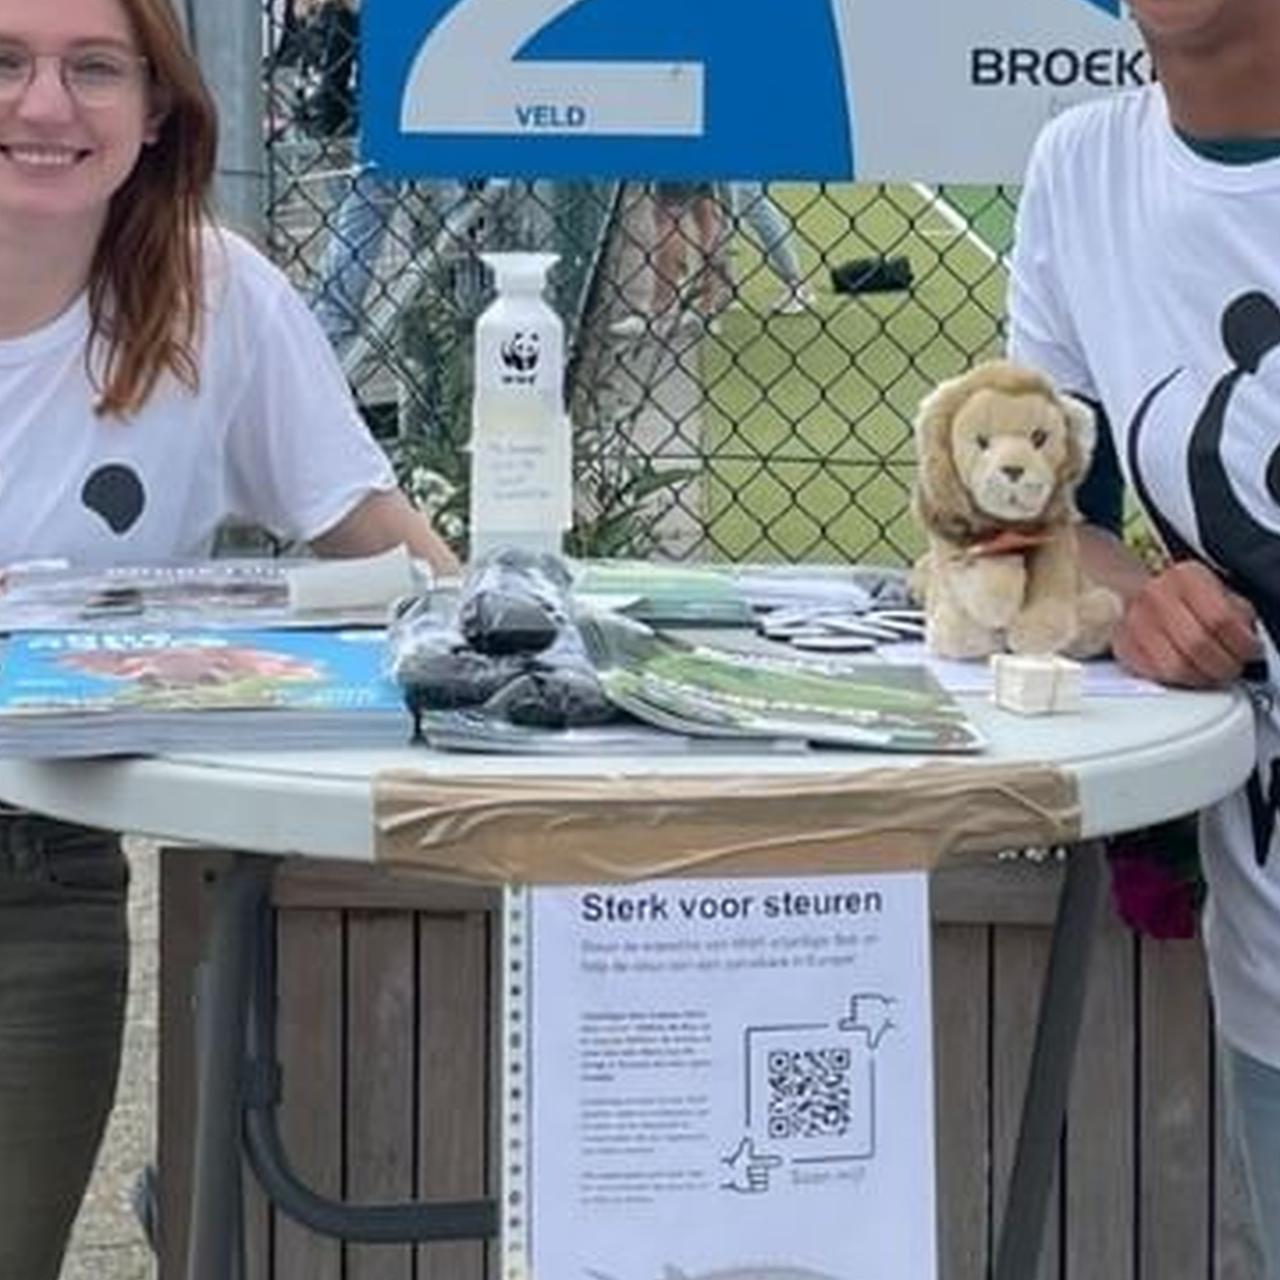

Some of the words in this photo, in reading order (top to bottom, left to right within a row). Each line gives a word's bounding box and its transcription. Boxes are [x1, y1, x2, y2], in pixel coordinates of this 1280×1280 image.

[971, 48, 1158, 87] BROEK
[515, 105, 587, 128] VELD
[581, 891, 669, 922] Sterk
[679, 895, 754, 920] voor
[763, 890, 883, 918] steuren
